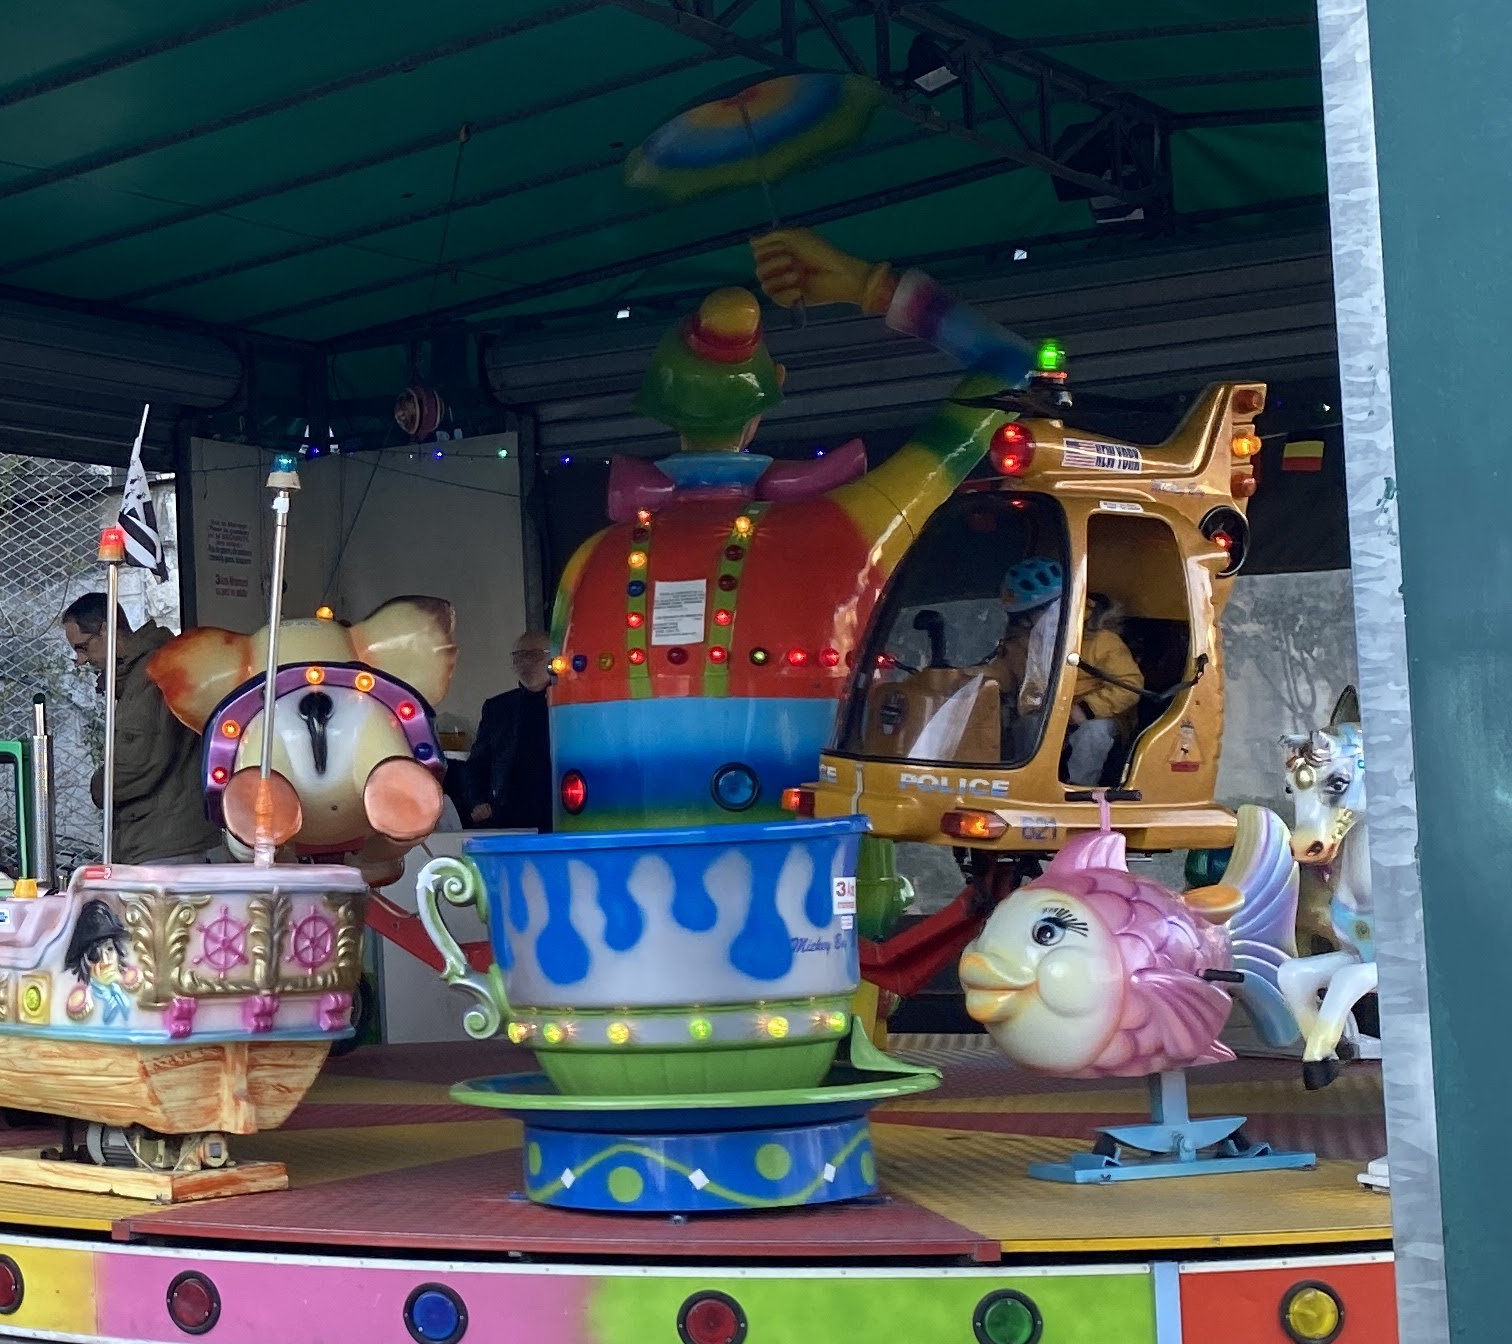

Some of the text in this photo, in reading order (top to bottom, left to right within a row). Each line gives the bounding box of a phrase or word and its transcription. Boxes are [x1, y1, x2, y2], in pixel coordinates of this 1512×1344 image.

[1095, 444, 1115, 468] NEW
[899, 772, 1010, 797] POLICE
[835, 881, 846, 897] 3
